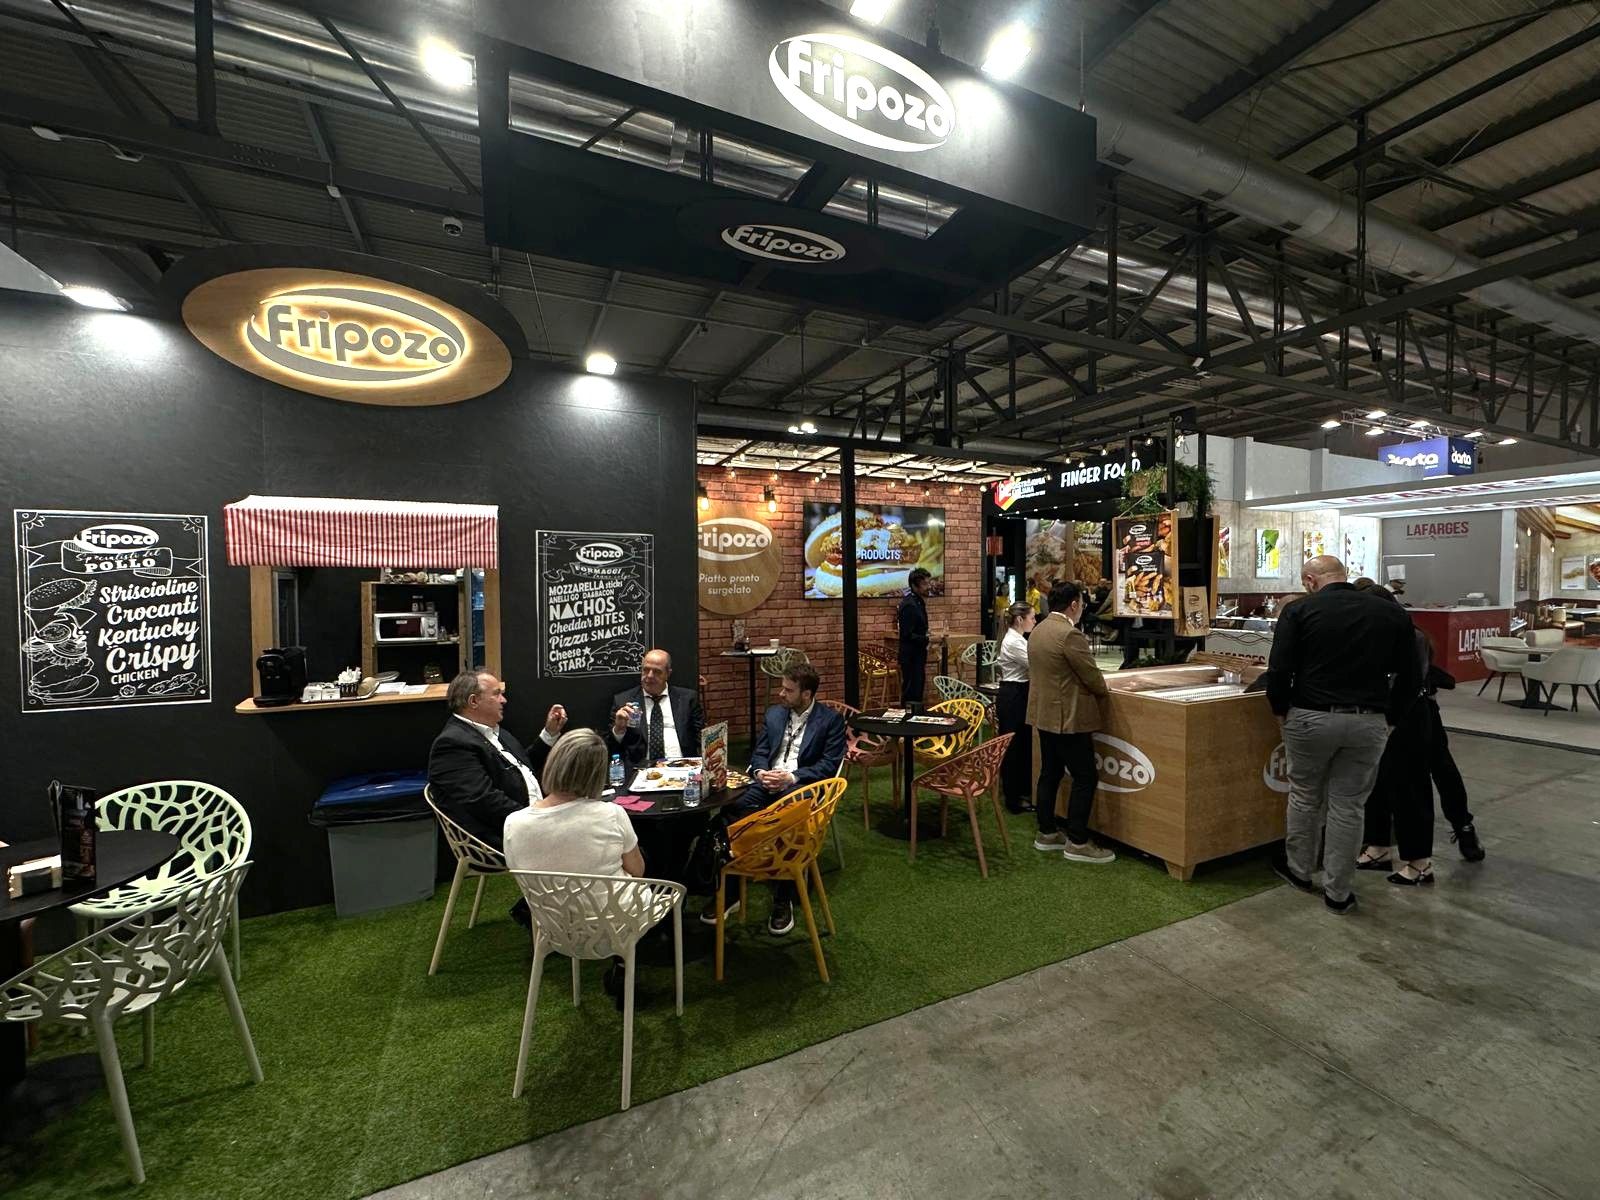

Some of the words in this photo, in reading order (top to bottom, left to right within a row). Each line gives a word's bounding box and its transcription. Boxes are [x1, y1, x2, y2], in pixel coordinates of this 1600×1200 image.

[787, 39, 951, 138] Fripozo
[732, 225, 838, 261] Fripozo
[267, 304, 458, 364] Fripozo
[1060, 467, 1101, 488] FINGER
[81, 530, 156, 548] Fripozo
[1406, 521, 1469, 537] LAFARGES
[580, 547, 621, 560] Fripozo
[84, 558, 156, 573] POLLO
[548, 580, 605, 597] MOZZARELLA
[698, 573, 727, 583] Piatto
[729, 573, 760, 584] pronto
[99, 579, 199, 604] Striscioline
[708, 584, 752, 597] surgelato
[106, 594, 199, 625] Crocanti
[549, 596, 616, 621] NACHOS
[97, 616, 200, 647] Kentucky
[549, 617, 593, 635] Cheddar
[593, 611, 626, 627] BITES
[548, 633, 589, 650] Pizza
[591, 624, 630, 641] SNACKS
[105, 642, 200, 674] Crispy
[549, 647, 582, 662] Cheese
[558, 656, 586, 672] STARS
[111, 668, 160, 685] CHICKEN
